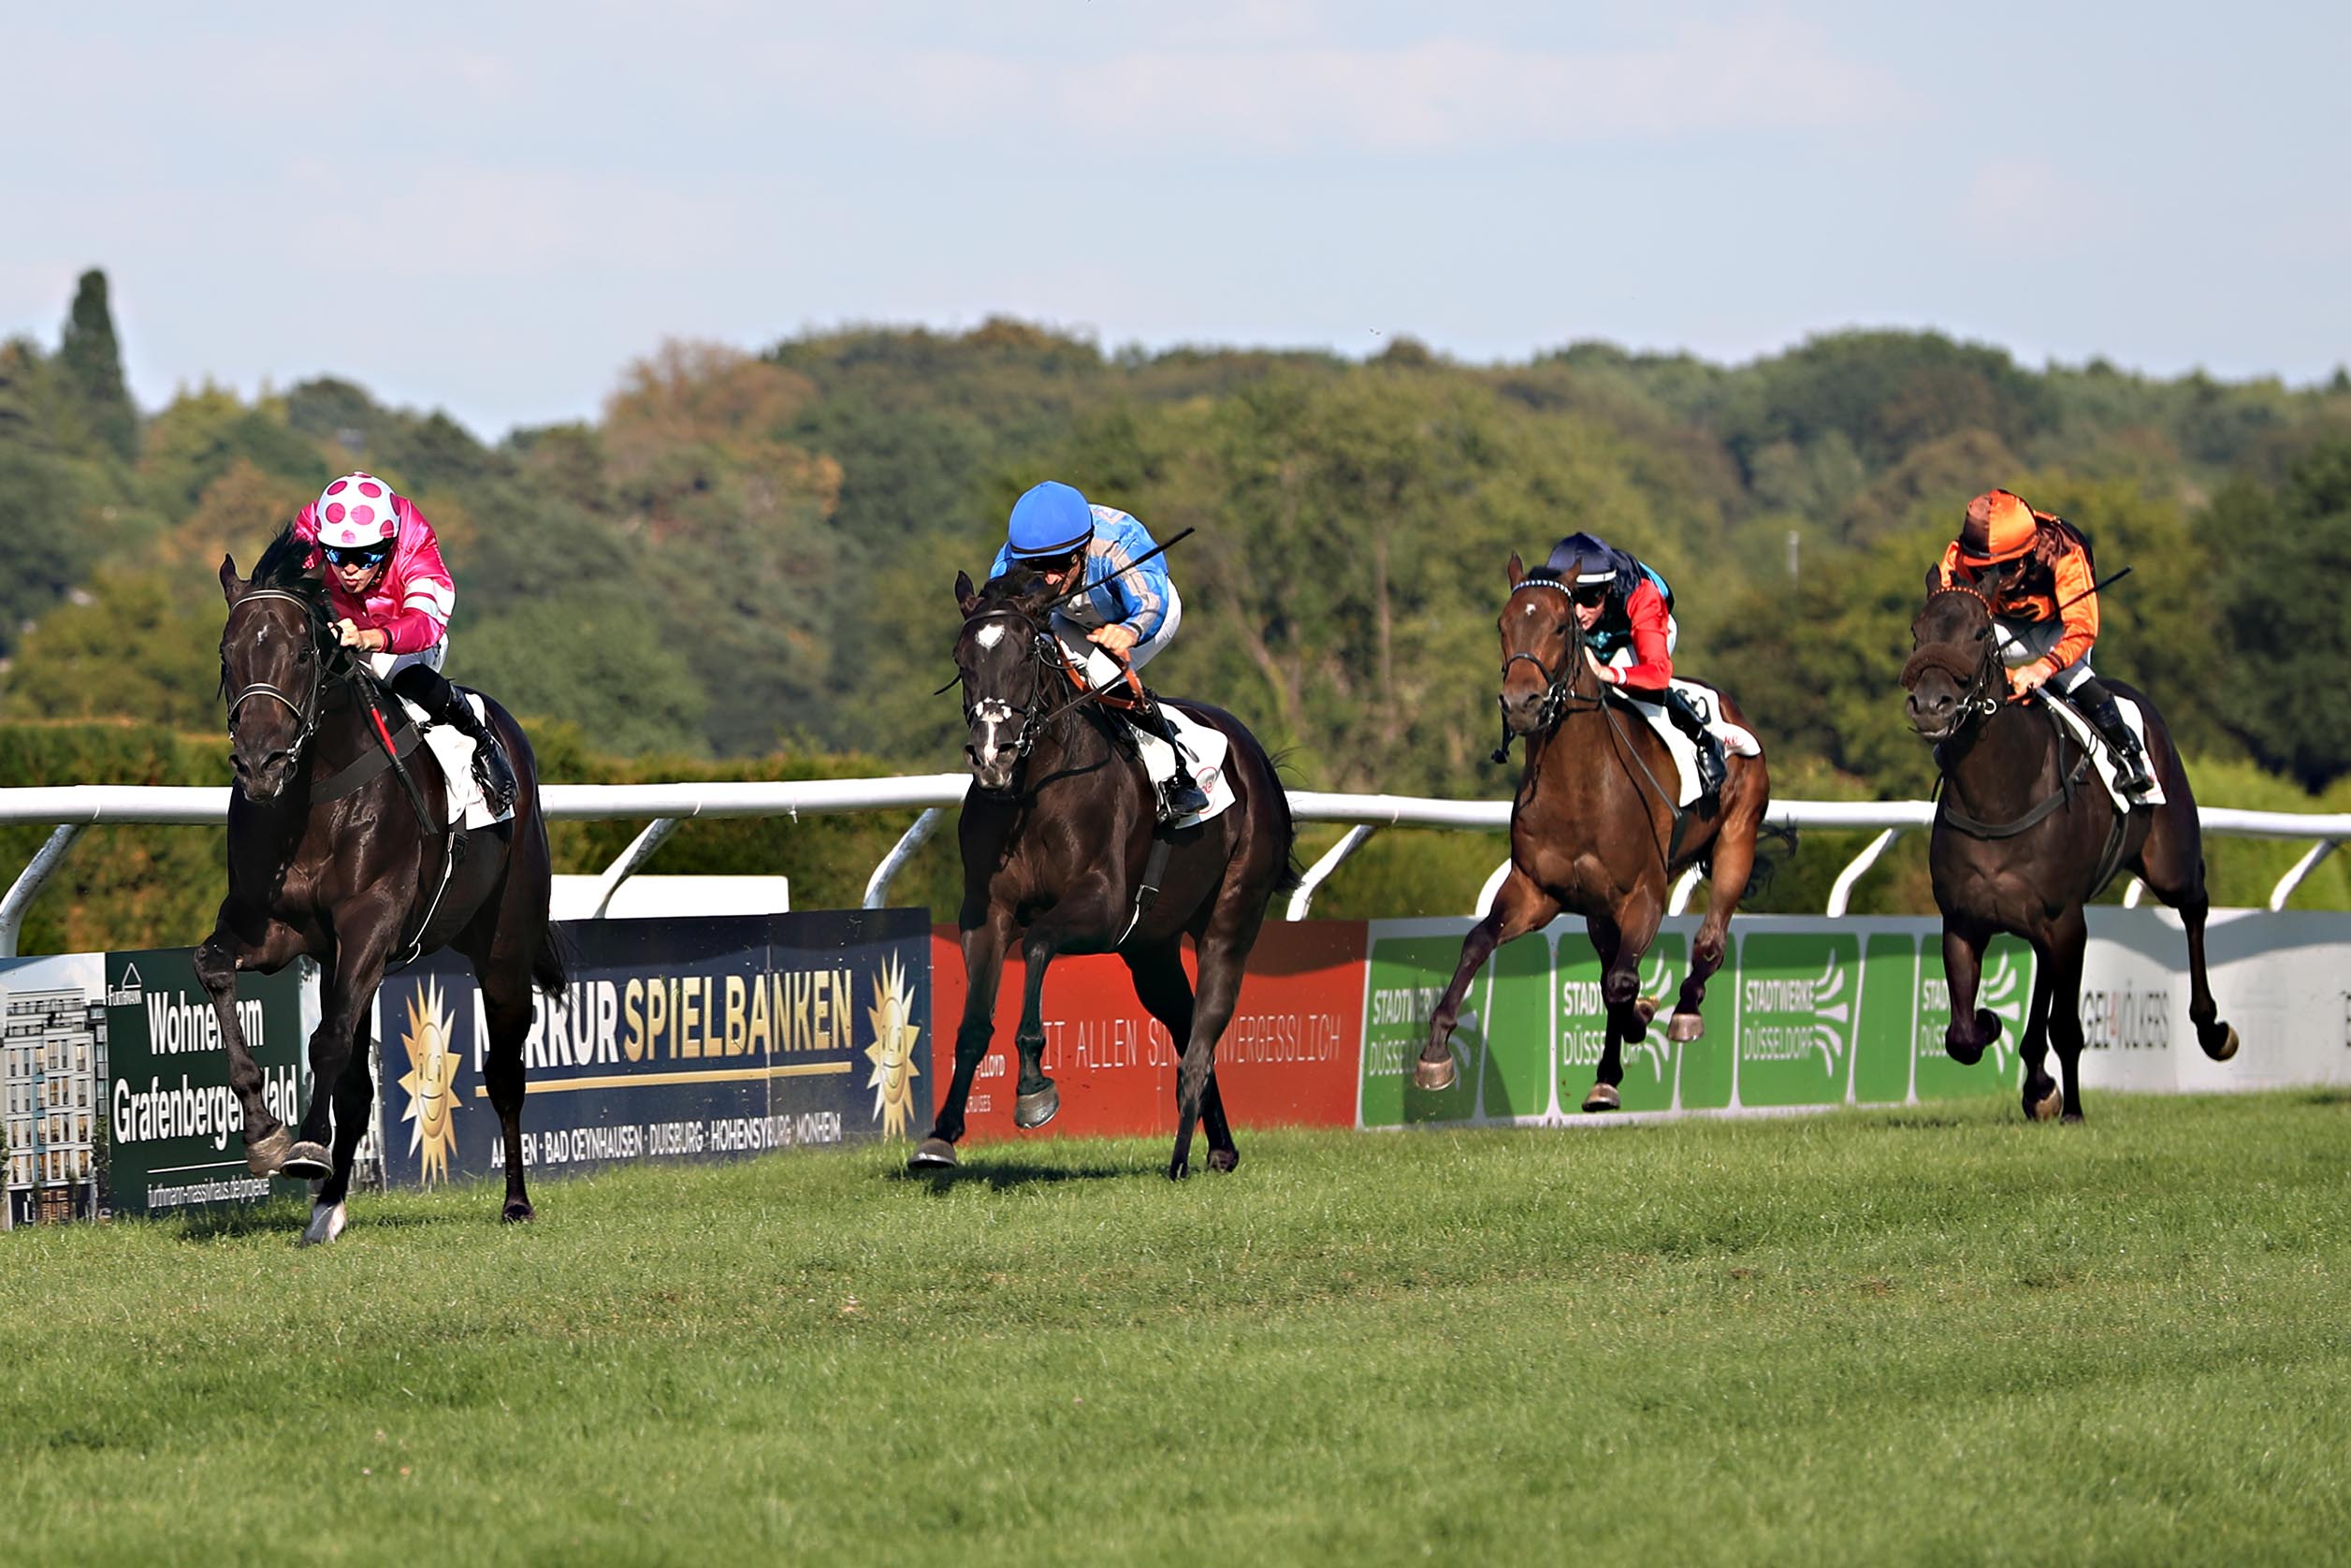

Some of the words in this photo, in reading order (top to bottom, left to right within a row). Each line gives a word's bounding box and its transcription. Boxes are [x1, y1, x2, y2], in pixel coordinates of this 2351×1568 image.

[473, 980, 619, 1072] MRKUR
[624, 969, 852, 1063] SPIELBANKEN
[1746, 980, 1814, 1012] STADTWERKE
[1076, 1019, 1138, 1069] ALLEN
[1745, 1020, 1813, 1061] DÜSSELDORF
[263, 1065, 298, 1126] ald
[491, 1133, 538, 1169] AAEN
[544, 1130, 570, 1164] BAD
[649, 1122, 704, 1155] DUISBURG
[711, 1114, 791, 1152] HOHENSYBURG
[796, 1111, 841, 1143] MONHEIM
